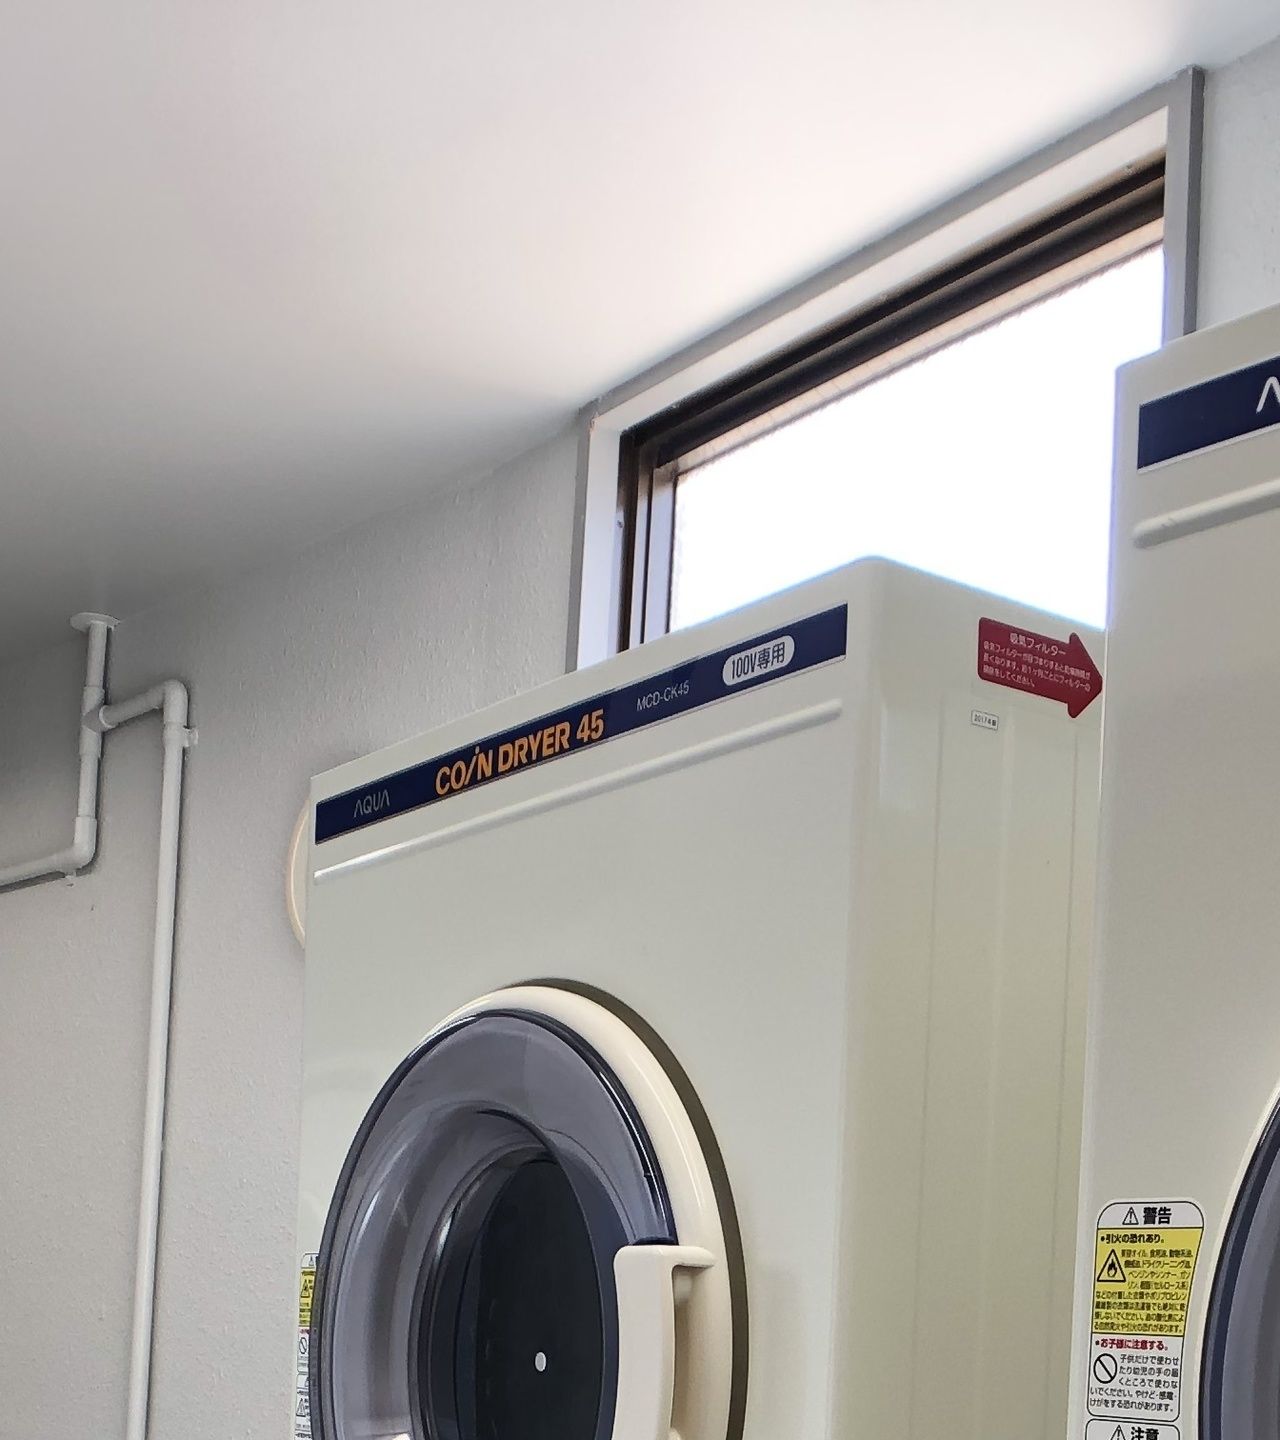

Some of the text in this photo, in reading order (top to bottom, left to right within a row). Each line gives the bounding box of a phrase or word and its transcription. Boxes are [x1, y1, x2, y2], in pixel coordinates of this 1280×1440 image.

[1010, 632, 1066, 656] 吸気フィルター
[353, 788, 391, 819] AQUA
[497, 726, 571, 777] DRYER
[577, 709, 605, 743] 45
[636, 680, 690, 712] MCD-CK45
[730, 641, 787, 678] 100V専用
[1142, 1206, 1172, 1225] 警告
